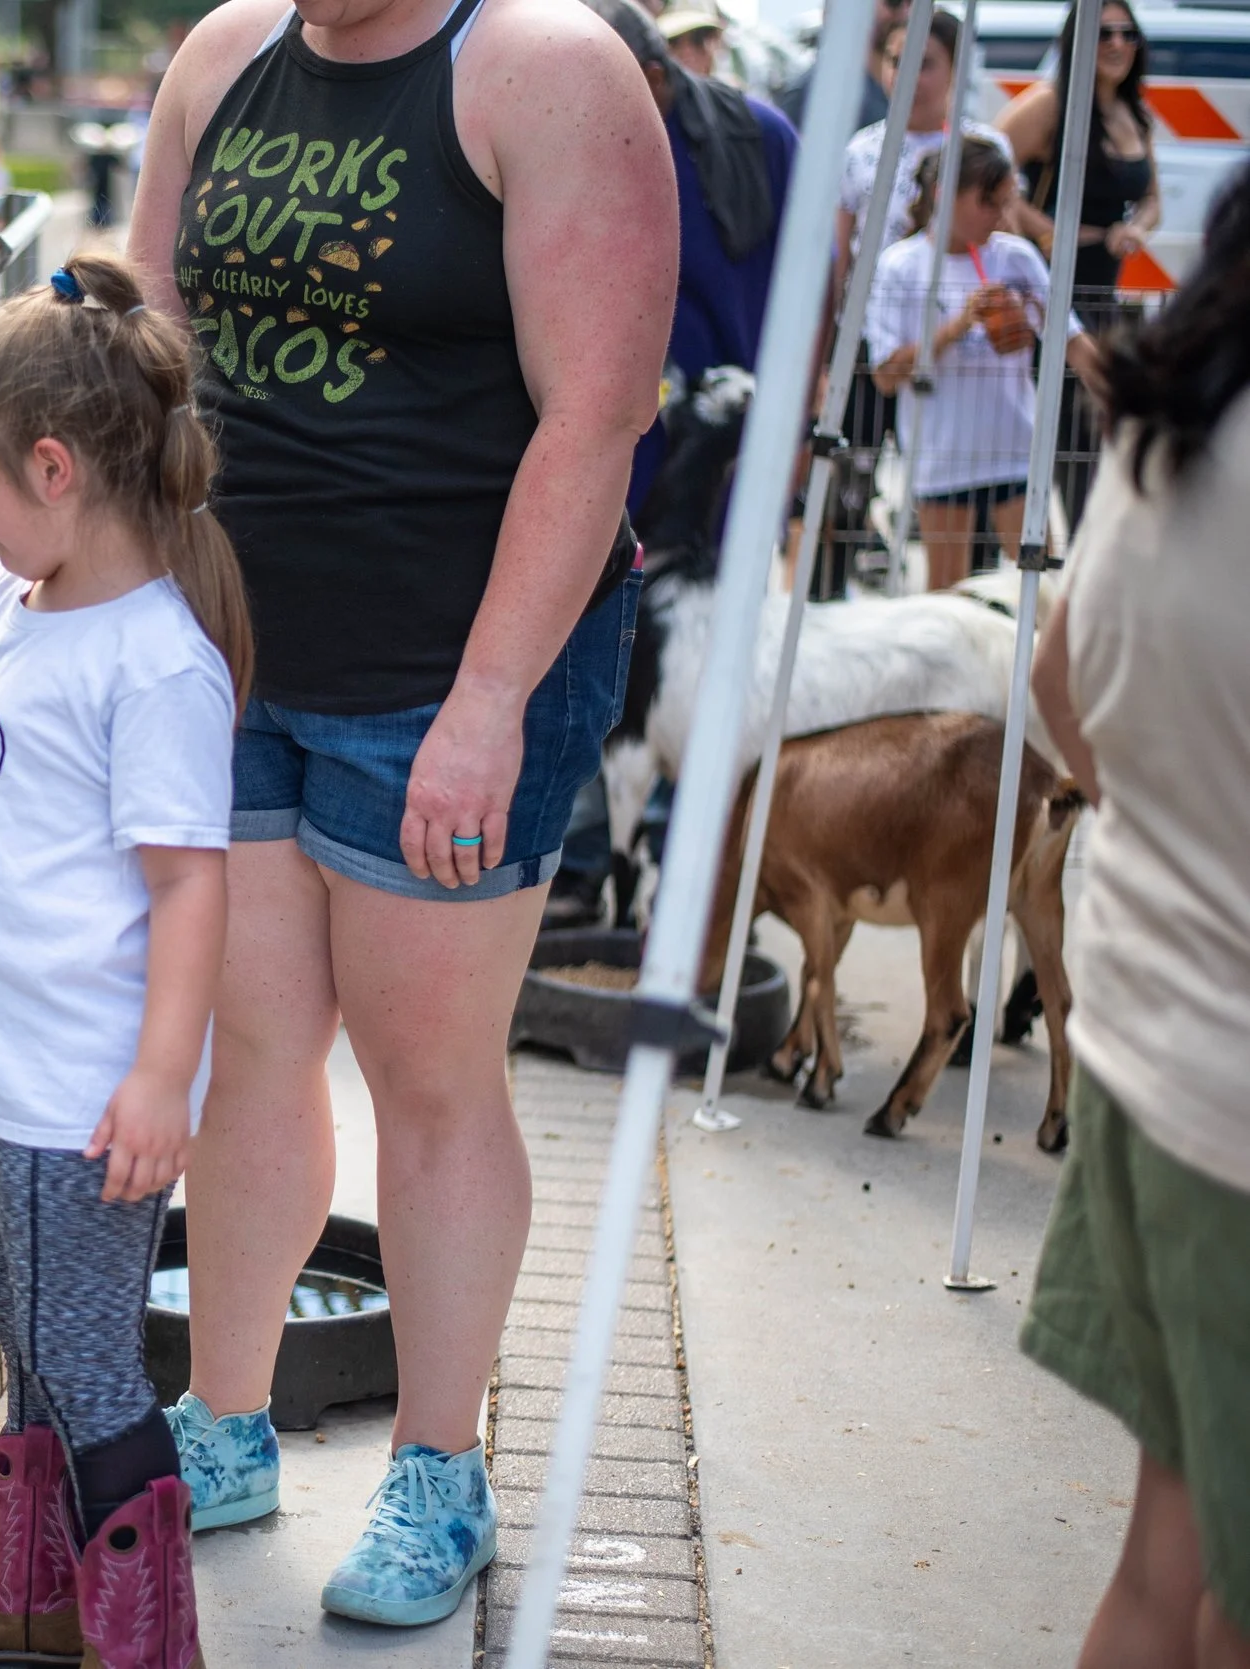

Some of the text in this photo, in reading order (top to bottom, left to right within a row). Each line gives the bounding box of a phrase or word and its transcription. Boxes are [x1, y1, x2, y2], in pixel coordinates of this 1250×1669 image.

[212, 127, 407, 211] WORKS
[203, 195, 342, 263] OUT
[212, 268, 290, 298] CLEARLY
[304, 284, 370, 319] LOVES
